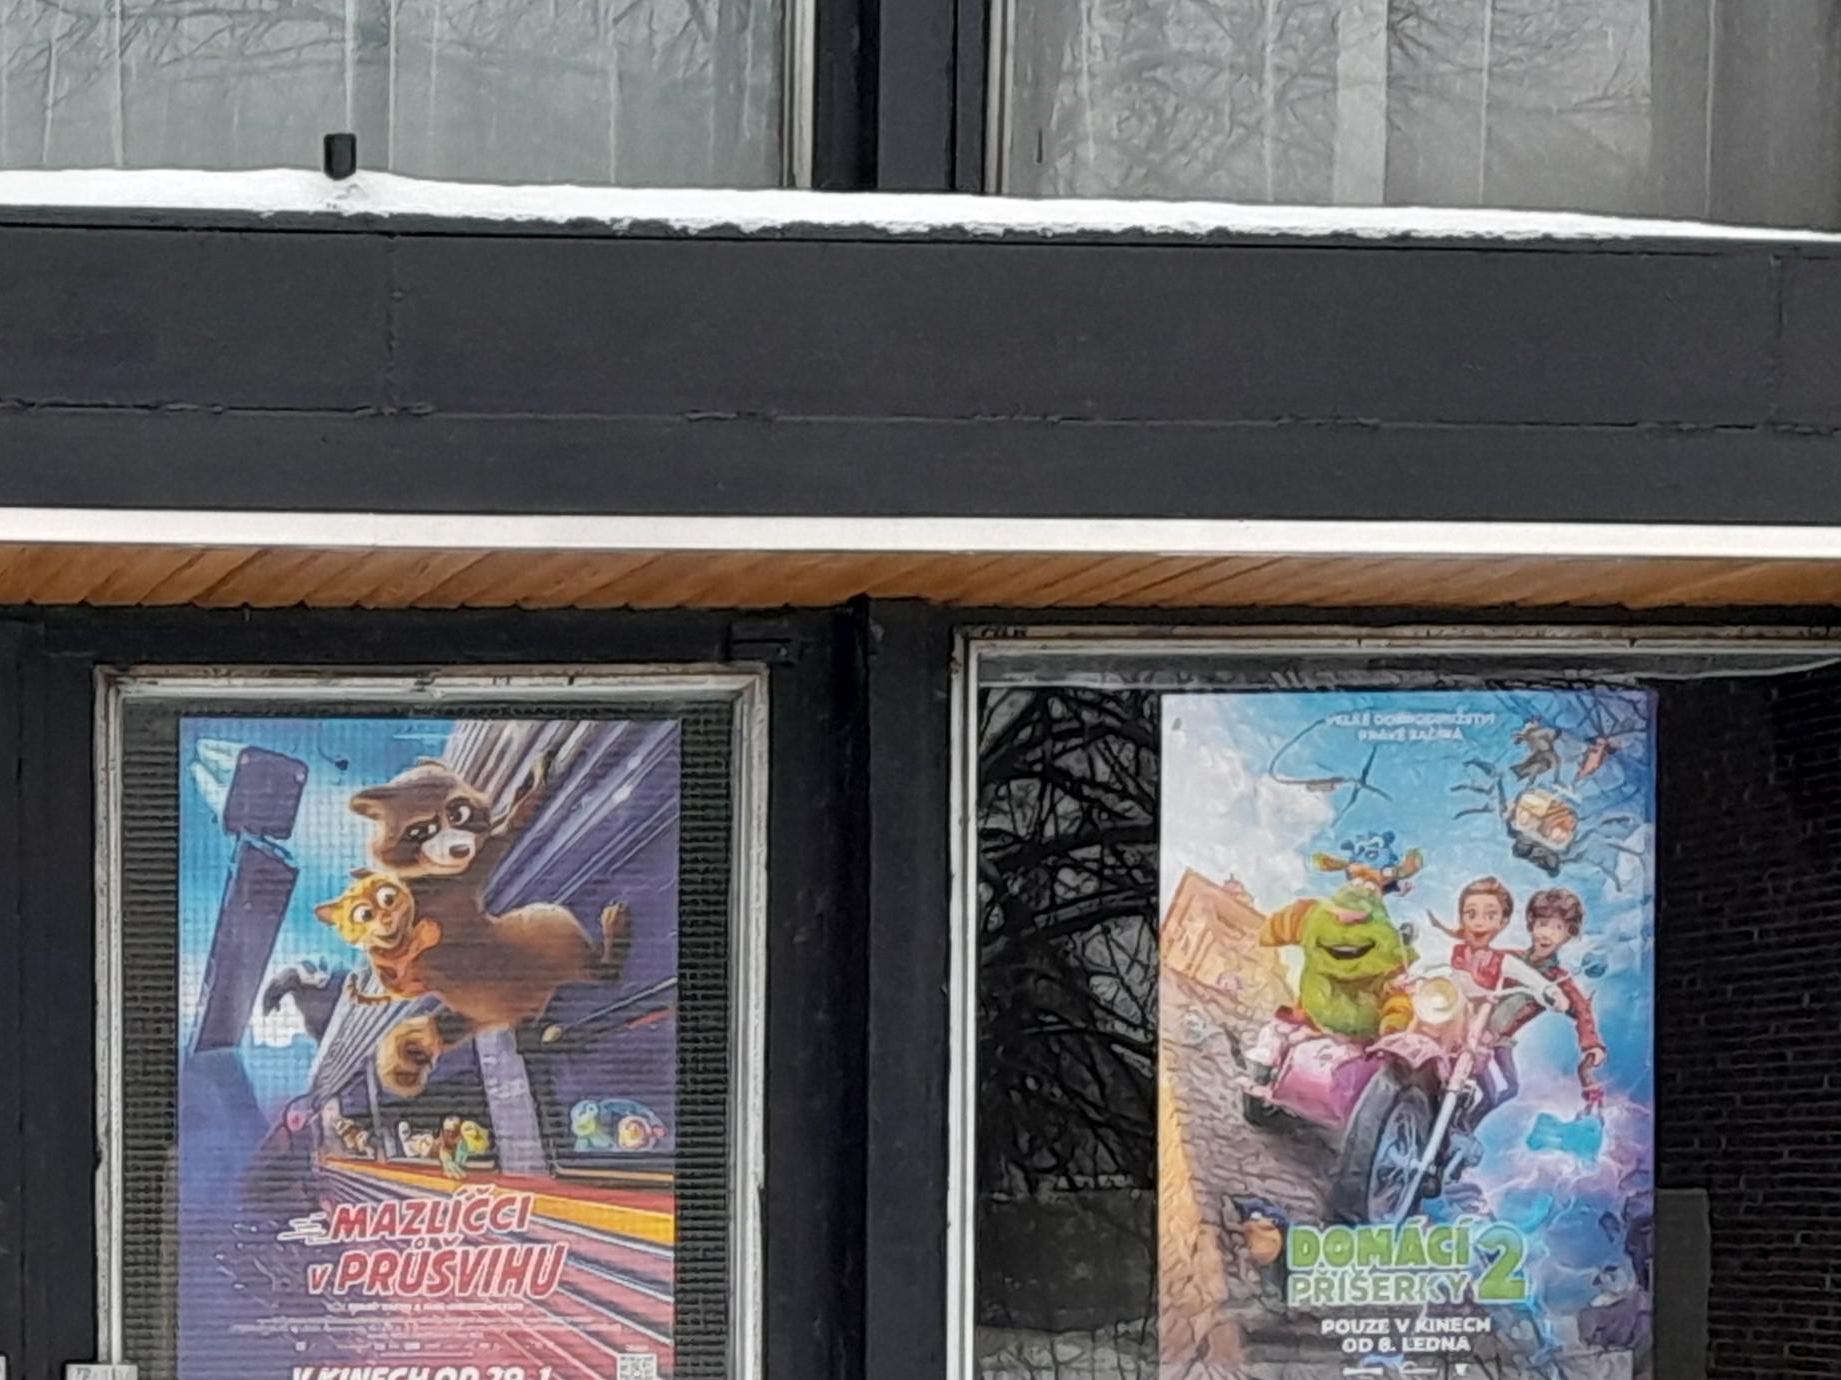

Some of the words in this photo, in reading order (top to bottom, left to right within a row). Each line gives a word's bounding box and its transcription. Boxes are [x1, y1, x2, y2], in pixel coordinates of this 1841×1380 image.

[329, 1184, 535, 1246] MAZLÍČCI
[335, 1235, 569, 1299] PRŮŠVIHU
[1288, 1215, 1474, 1271] DOMÁCÍ
[1474, 1222, 1529, 1303] 2
[1287, 1265, 1473, 1307] PŘÍŠERKY
[1320, 1318, 1390, 1335] POUZE
[1394, 1317, 1410, 1333] V
[1414, 1316, 1491, 1334] KINECH
[1341, 1337, 1374, 1354] OD
[1401, 1336, 1472, 1352] LEDNA
